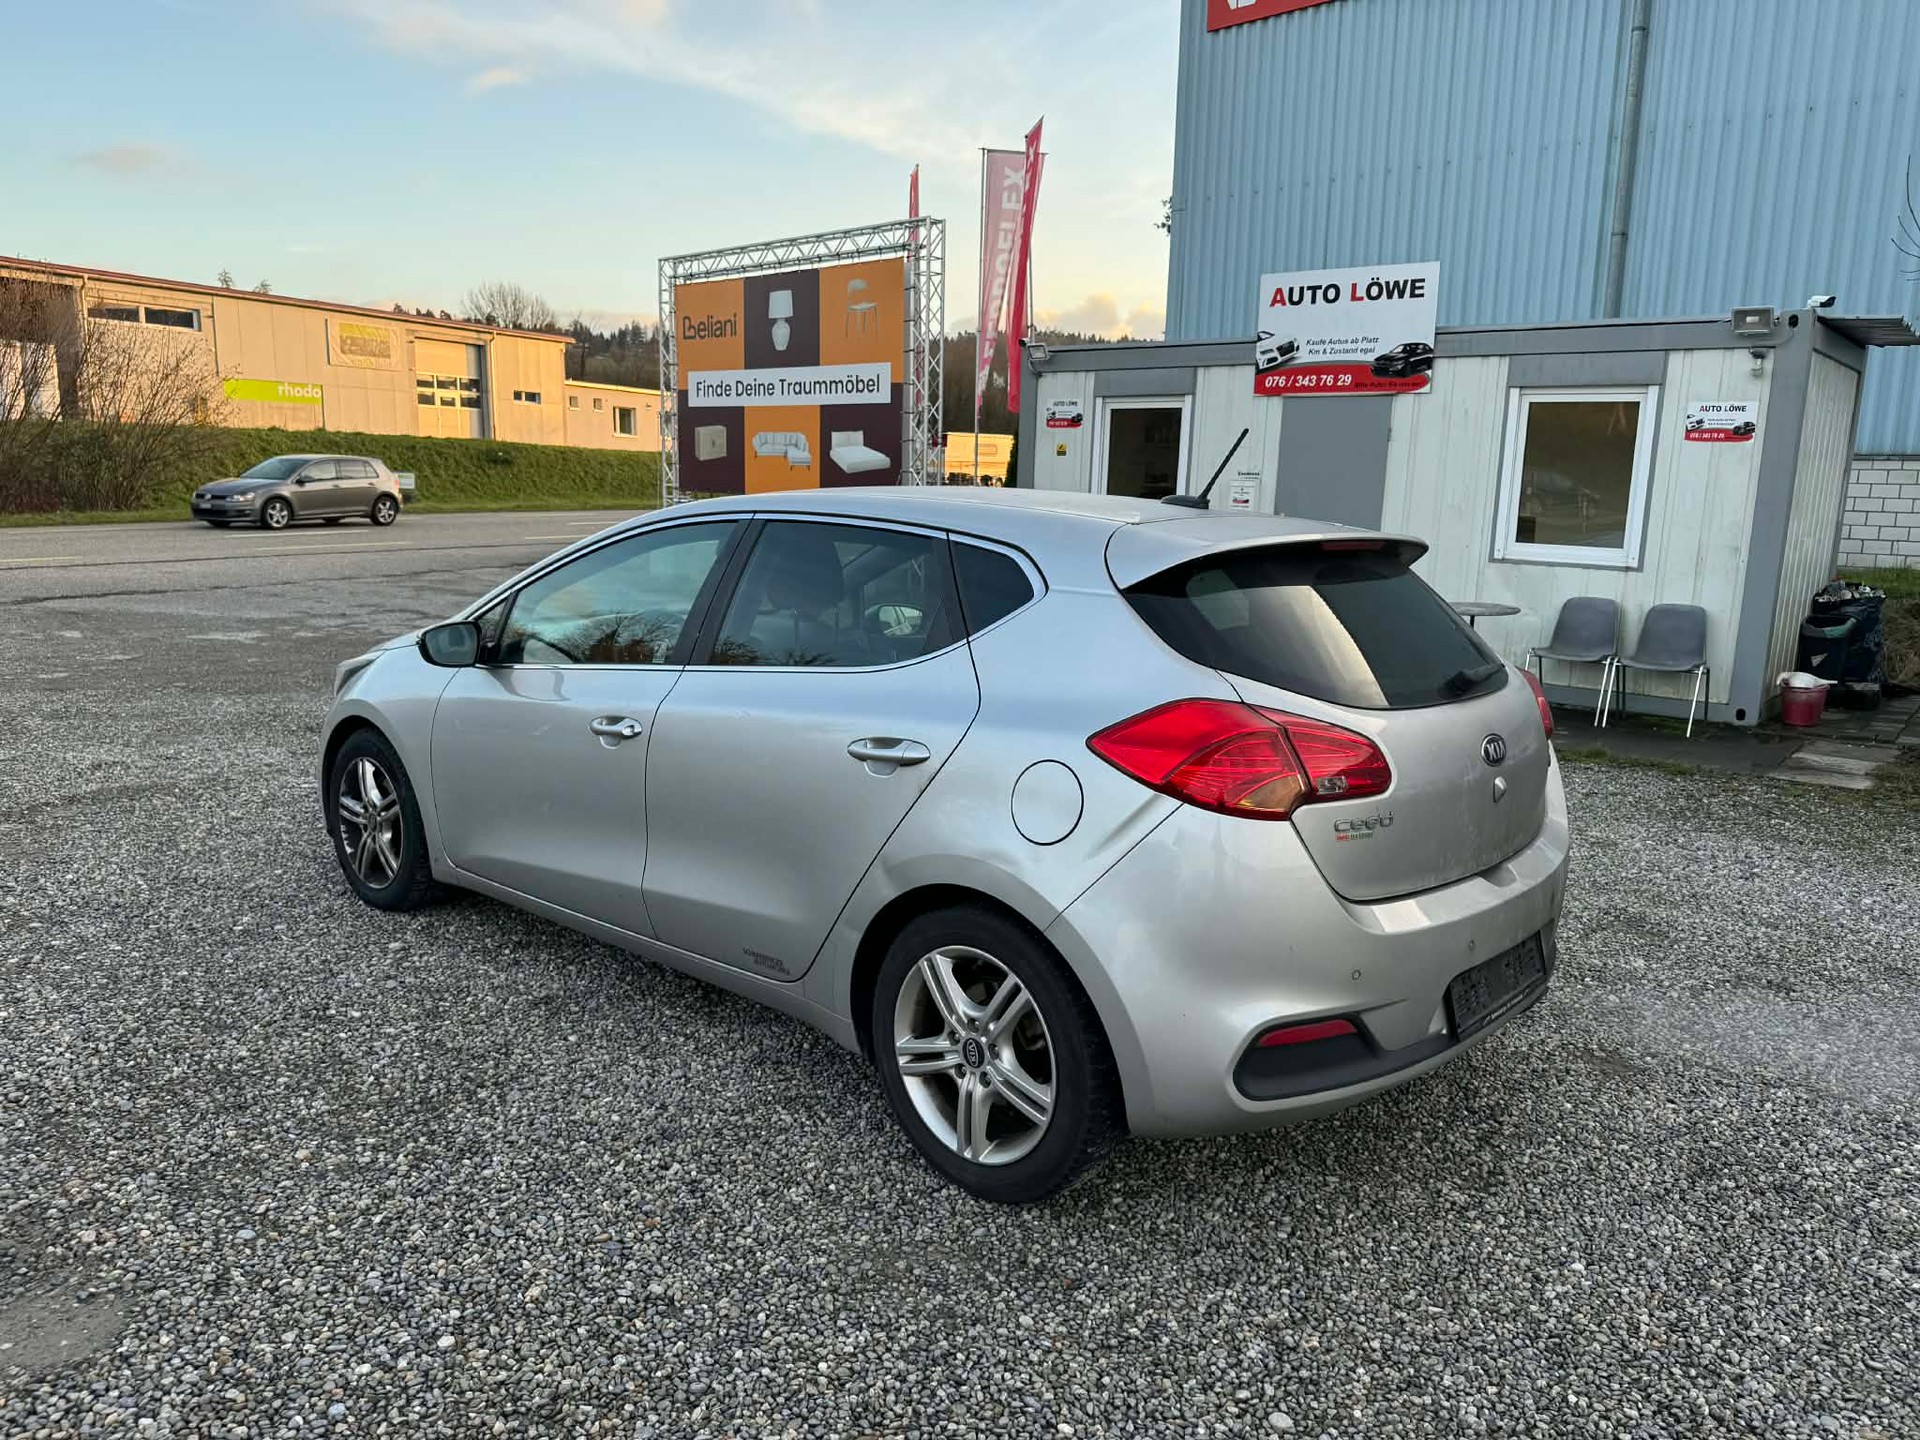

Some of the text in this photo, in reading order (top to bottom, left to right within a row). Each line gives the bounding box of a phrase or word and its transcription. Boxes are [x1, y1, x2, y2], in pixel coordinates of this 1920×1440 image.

[1270, 277, 1426, 308] AUTO LÖWE
[683, 313, 737, 340] Beliani
[1306, 338, 1327, 346] Kaufe
[1361, 336, 1380, 344] Platz
[1329, 347, 1358, 355] Zustand
[1359, 346, 1376, 354] egal
[695, 374, 880, 398] Finde Deine Traummöbel
[1265, 375, 1286, 388] 076
[1296, 374, 1317, 387] 343
[1320, 374, 1335, 386] 76
[1337, 373, 1353, 386] 29
[277, 382, 321, 398] rhodo
[1486, 741, 1506, 760] KIA
